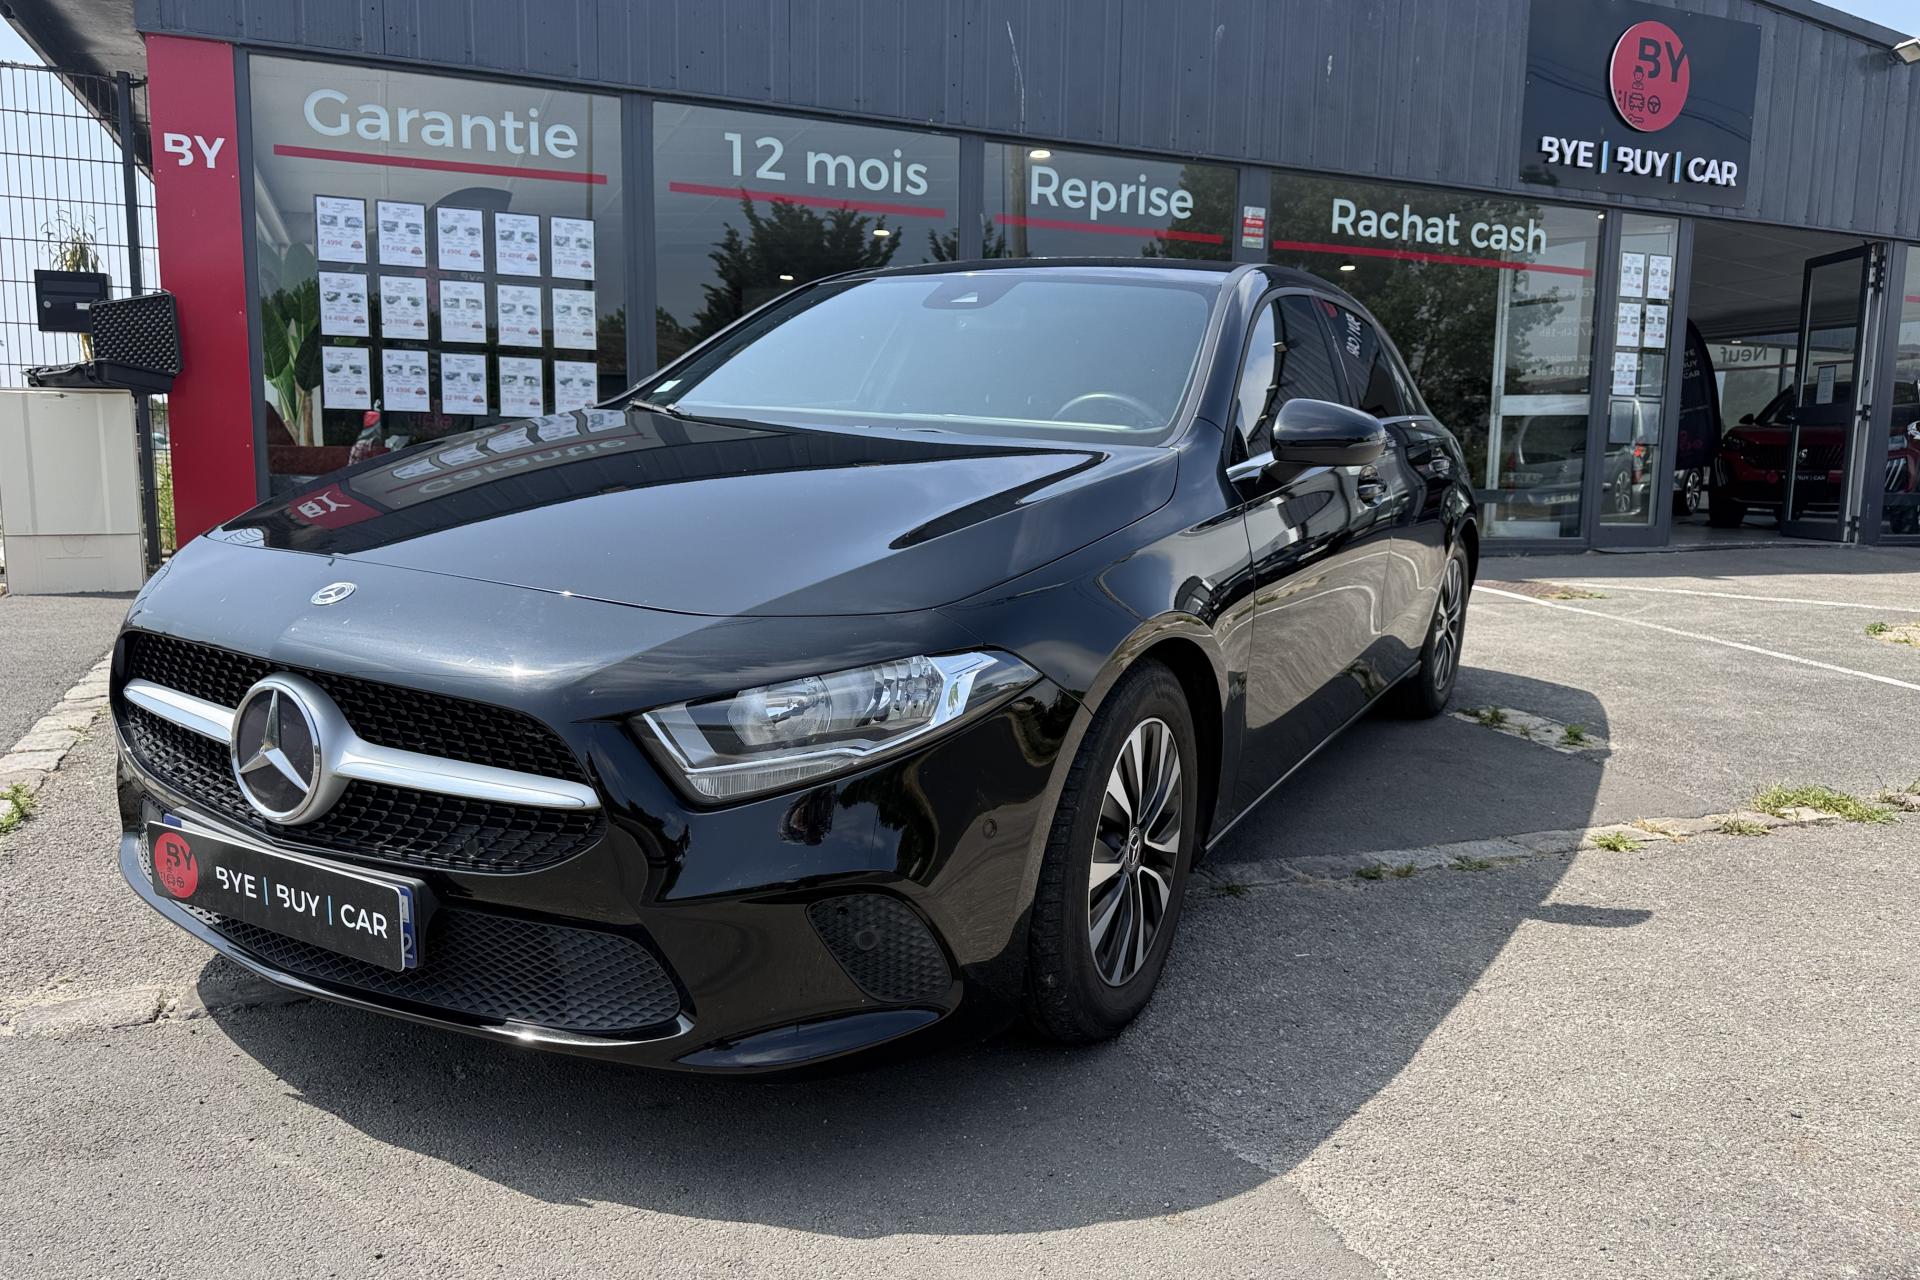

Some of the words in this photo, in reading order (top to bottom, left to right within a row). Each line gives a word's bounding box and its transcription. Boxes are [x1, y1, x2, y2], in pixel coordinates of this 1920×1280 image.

[1638, 37, 1688, 82] BY
[163, 132, 225, 169] BY
[303, 88, 579, 159] Garantie
[724, 131, 786, 181] 12
[806, 148, 928, 195] mois
[1541, 136, 1595, 167] BYE
[1616, 146, 1669, 177] BUY
[1687, 157, 1738, 187] CAR
[1030, 165, 1194, 220] Reprise
[1331, 198, 1461, 246] Rachat
[1470, 217, 1547, 254] cash
[165, 842, 194, 871] BY
[215, 866, 257, 898] BYE
[276, 884, 320, 917] BUY
[340, 904, 388, 939] CAR
